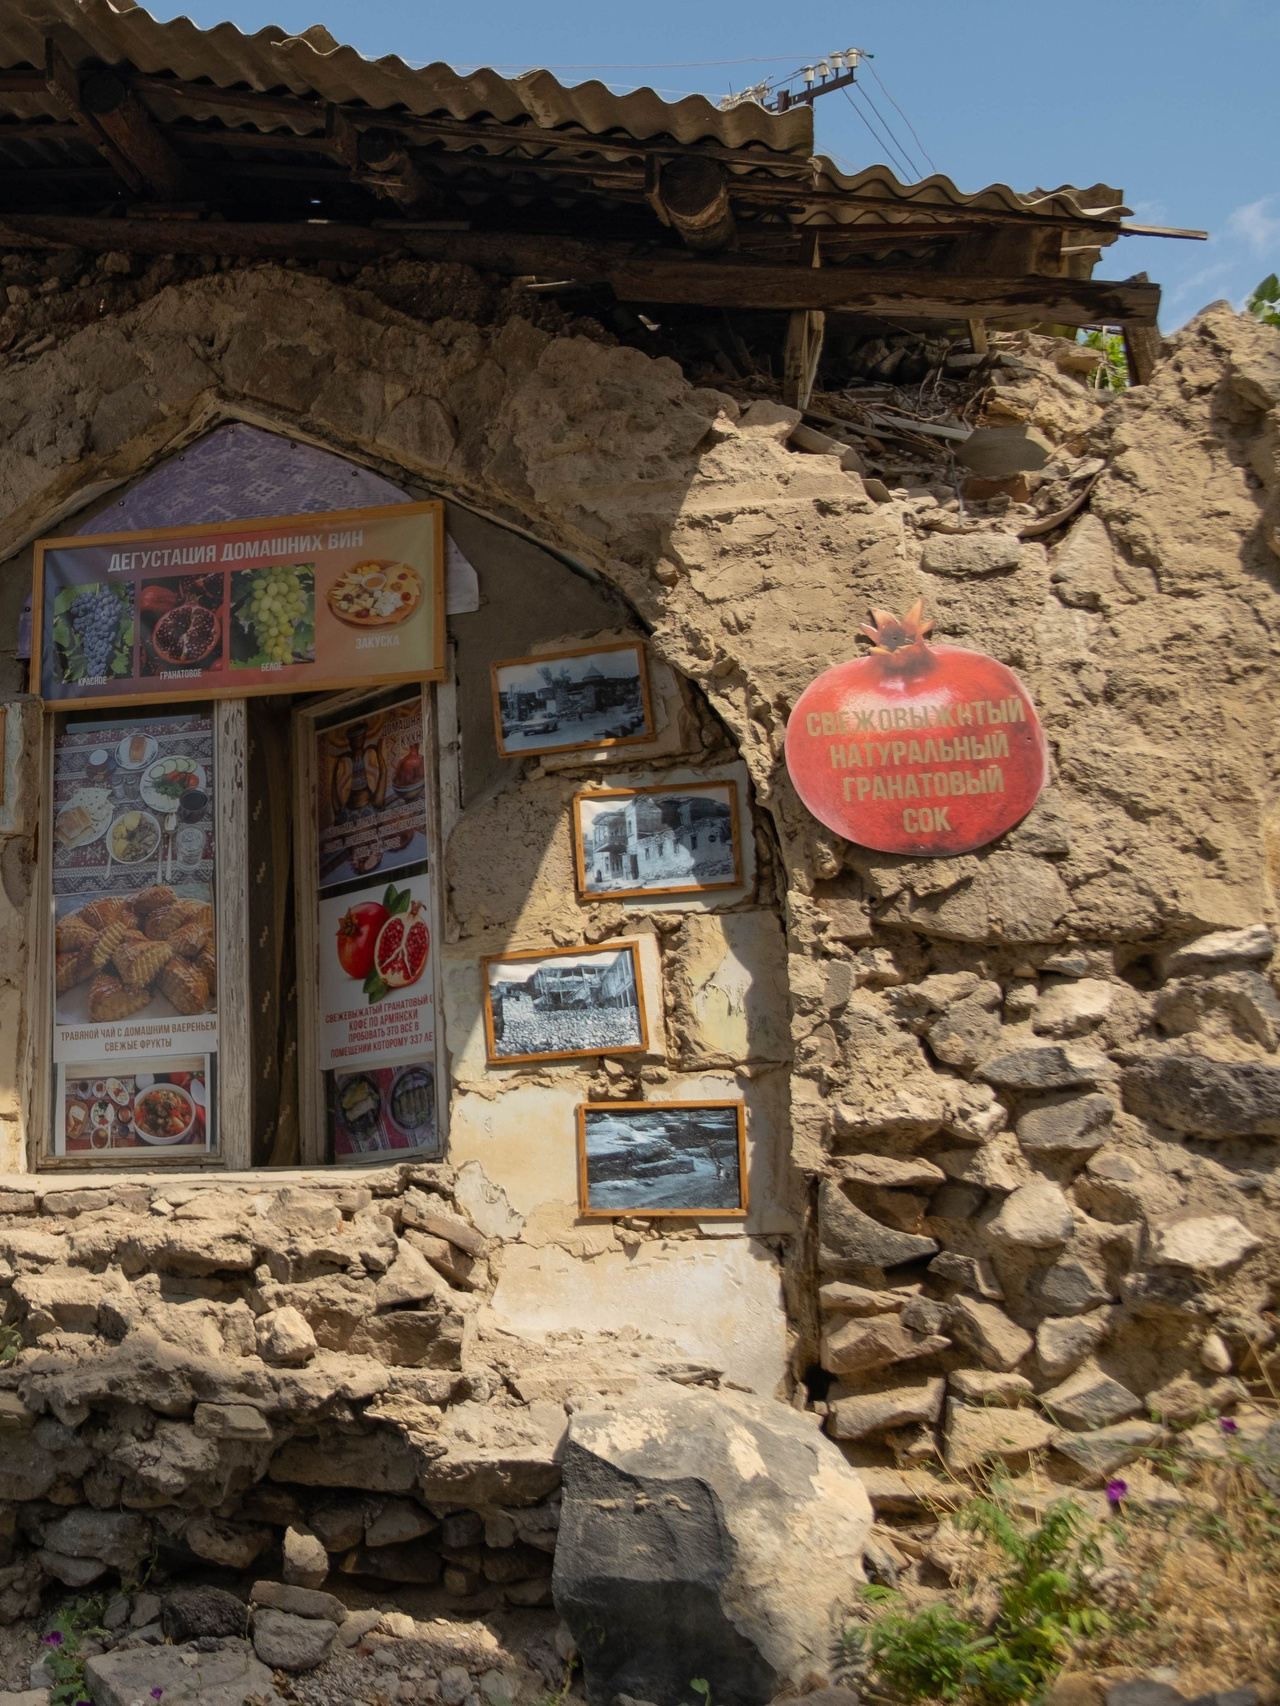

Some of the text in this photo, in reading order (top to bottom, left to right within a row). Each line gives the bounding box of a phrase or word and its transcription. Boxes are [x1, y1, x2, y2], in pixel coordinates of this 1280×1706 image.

[107, 530, 364, 573] ДЕГУСТАЦИЯ ДОМАШНИХ ВИН
[355, 635, 400, 650] ЗАКУСКА
[159, 668, 203, 681] ГРАНАТОВОЕ
[260, 661, 284, 672] БЕЛОЕ
[77, 676, 107, 687] КРАСНОЕ
[382, 712, 423, 737] ДОМАШНЯ
[400, 729, 424, 747] КУХН
[829, 729, 1010, 769] НАТУРАЛЬНЫЙ
[843, 764, 1006, 802] ГРАНАТОВЫЙ
[902, 806, 953, 834] СОК
[325, 1003, 383, 1024] СВЕЖЕВЫЖАТЫЙ
[384, 994, 429, 1013] ГРАНАТОВЫЙ
[348, 1008, 419, 1031] КОФЕ ПО АРМЯНСКИ
[61, 1021, 217, 1041] ТРАВЯНОЙ ЧАЙ С ДОМАШНИМ ВАЕРЕНЬЕМ
[348, 1028, 386, 1043] ПРОБОВАТЬ
[386, 1025, 399, 1036] ЭТО
[414, 1021, 419, 1031] В
[373, 1036, 408, 1052] КОТОРОМУ
[409, 1033, 423, 1045] 337
[424, 1031, 434, 1042] ЛЕ
[139, 1038, 172, 1049] ФРУКТЫ
